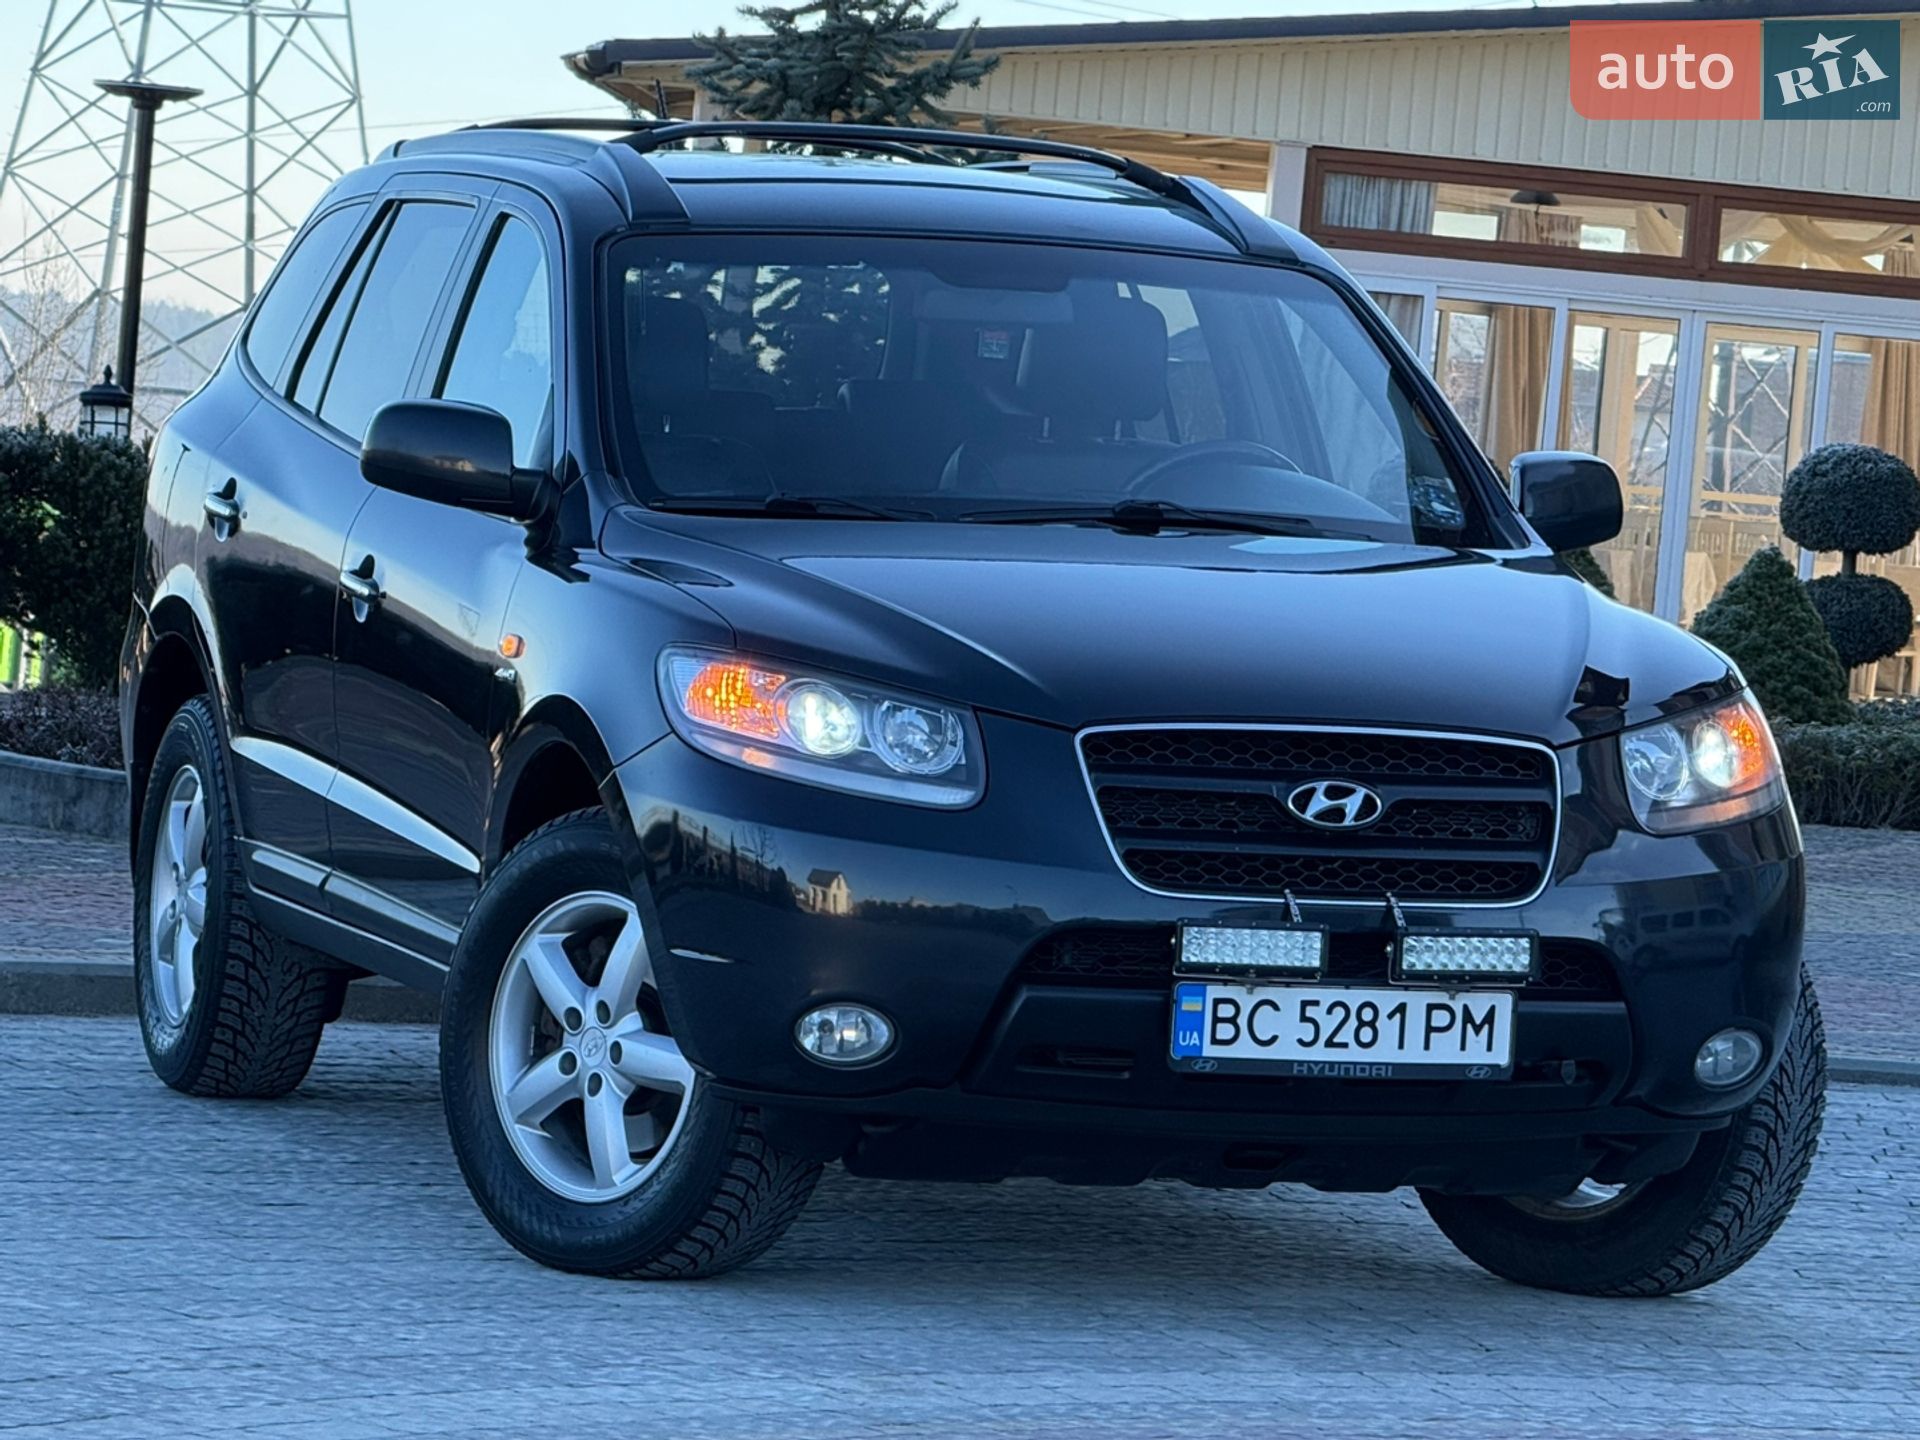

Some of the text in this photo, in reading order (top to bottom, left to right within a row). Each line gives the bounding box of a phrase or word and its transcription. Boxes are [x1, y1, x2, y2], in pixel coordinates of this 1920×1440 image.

[1209, 997, 1496, 1053] BC 5281 PM
[1179, 1031, 1200, 1046] UA
[1293, 1062, 1393, 1077] HYUNDAI
